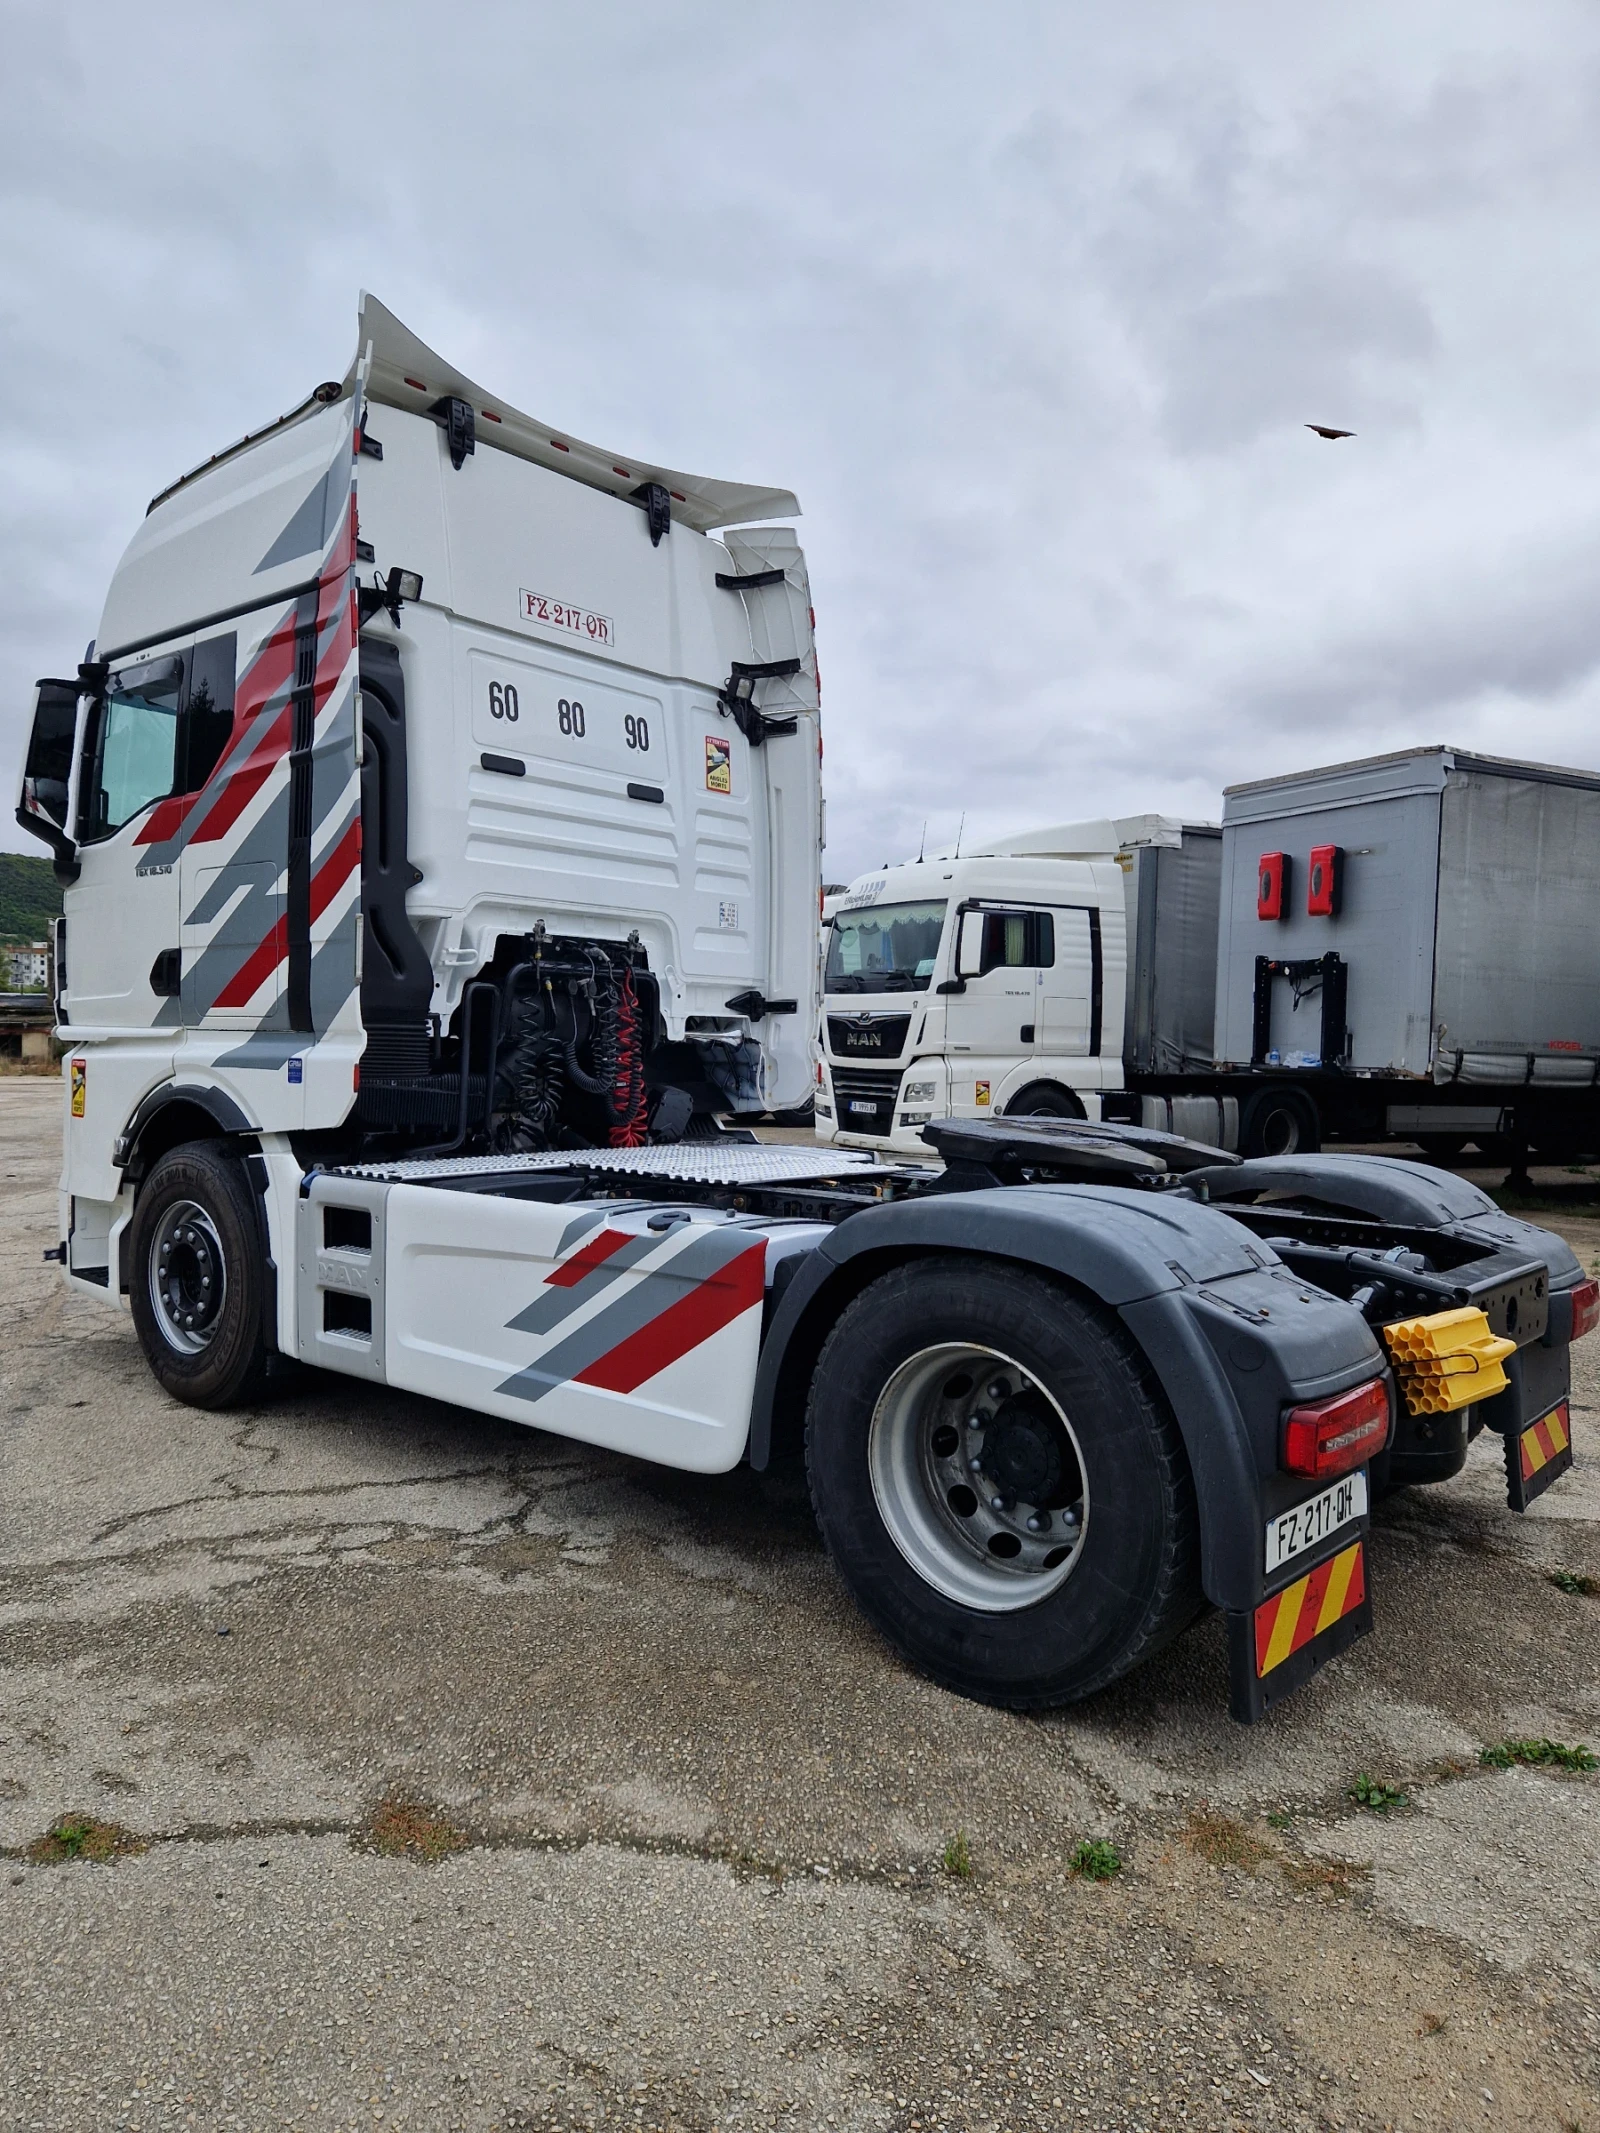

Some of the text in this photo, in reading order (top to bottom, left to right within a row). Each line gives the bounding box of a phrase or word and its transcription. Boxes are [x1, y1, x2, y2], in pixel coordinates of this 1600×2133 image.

[489, 681, 649, 751] 60 80 90
[847, 1032, 882, 1046] MAN
[318, 1261, 369, 1289] MAN
